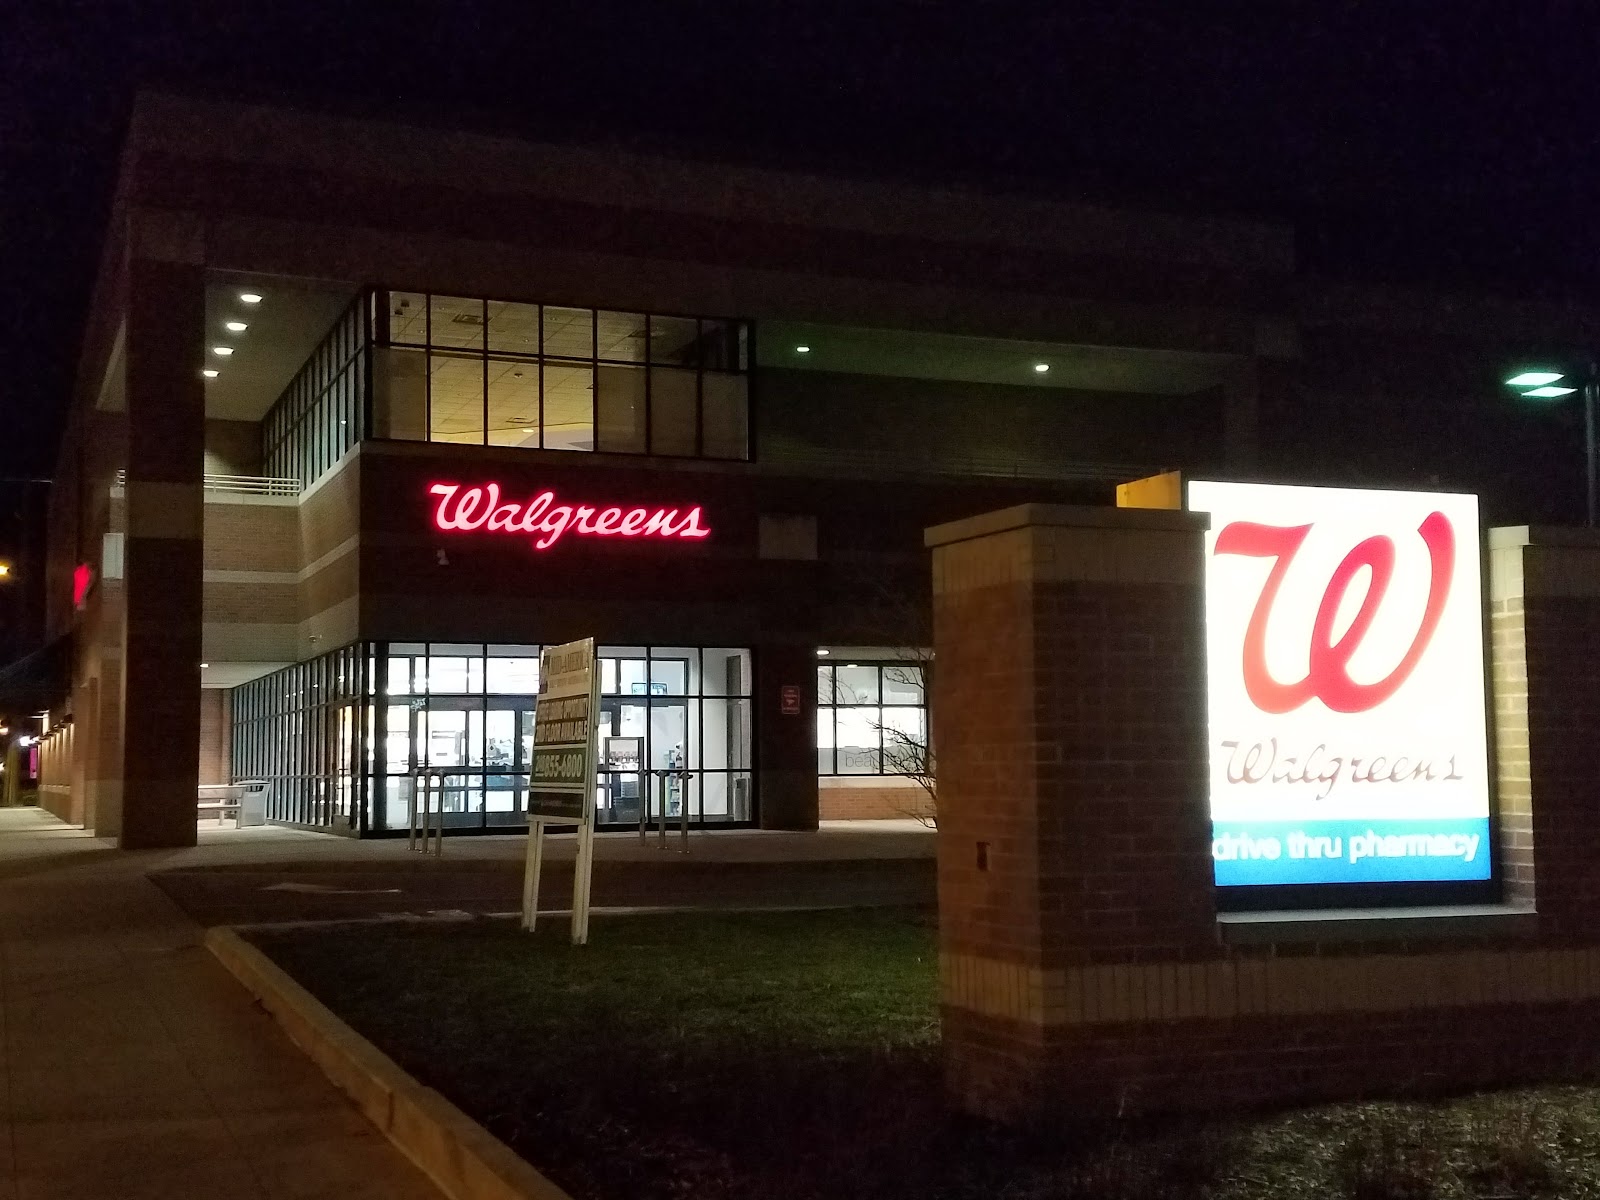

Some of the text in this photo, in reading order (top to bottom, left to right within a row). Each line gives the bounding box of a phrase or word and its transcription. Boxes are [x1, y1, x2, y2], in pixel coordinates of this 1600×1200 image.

[430, 483, 711, 549] Walgreens
[1214, 511, 1455, 714] W
[1221, 738, 1463, 800] Walgreens
[1212, 829, 1480, 864] drive thru pharmacy
